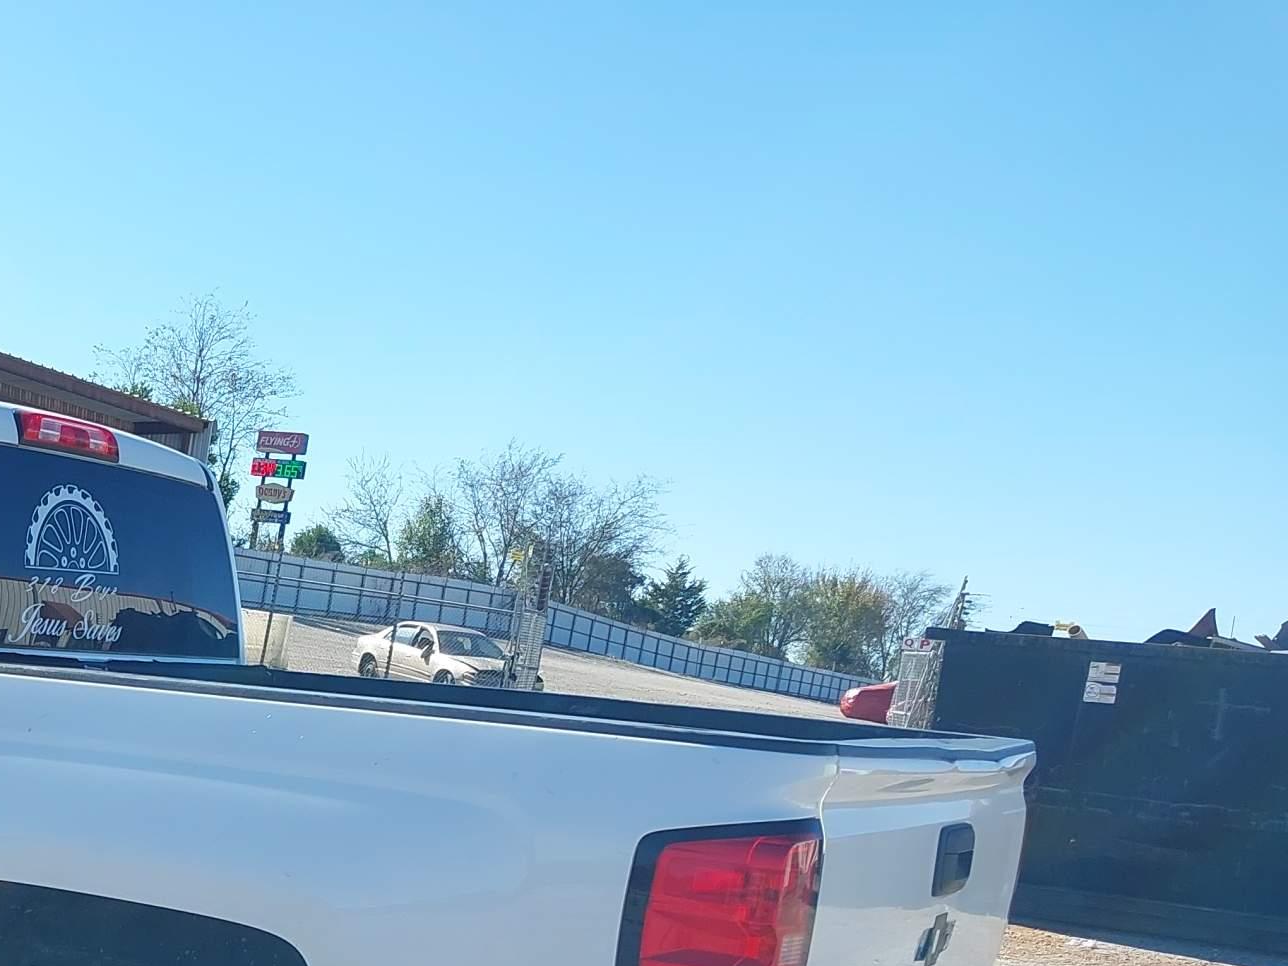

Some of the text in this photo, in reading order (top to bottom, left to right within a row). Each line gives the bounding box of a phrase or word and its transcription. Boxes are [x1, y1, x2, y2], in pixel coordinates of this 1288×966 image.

[259, 436, 289, 447] FLYING
[25, 576, 64, 594] 318
[7, 603, 123, 643] Jesus Saves
[904, 638, 915, 649] Q
[919, 639, 931, 650] P
